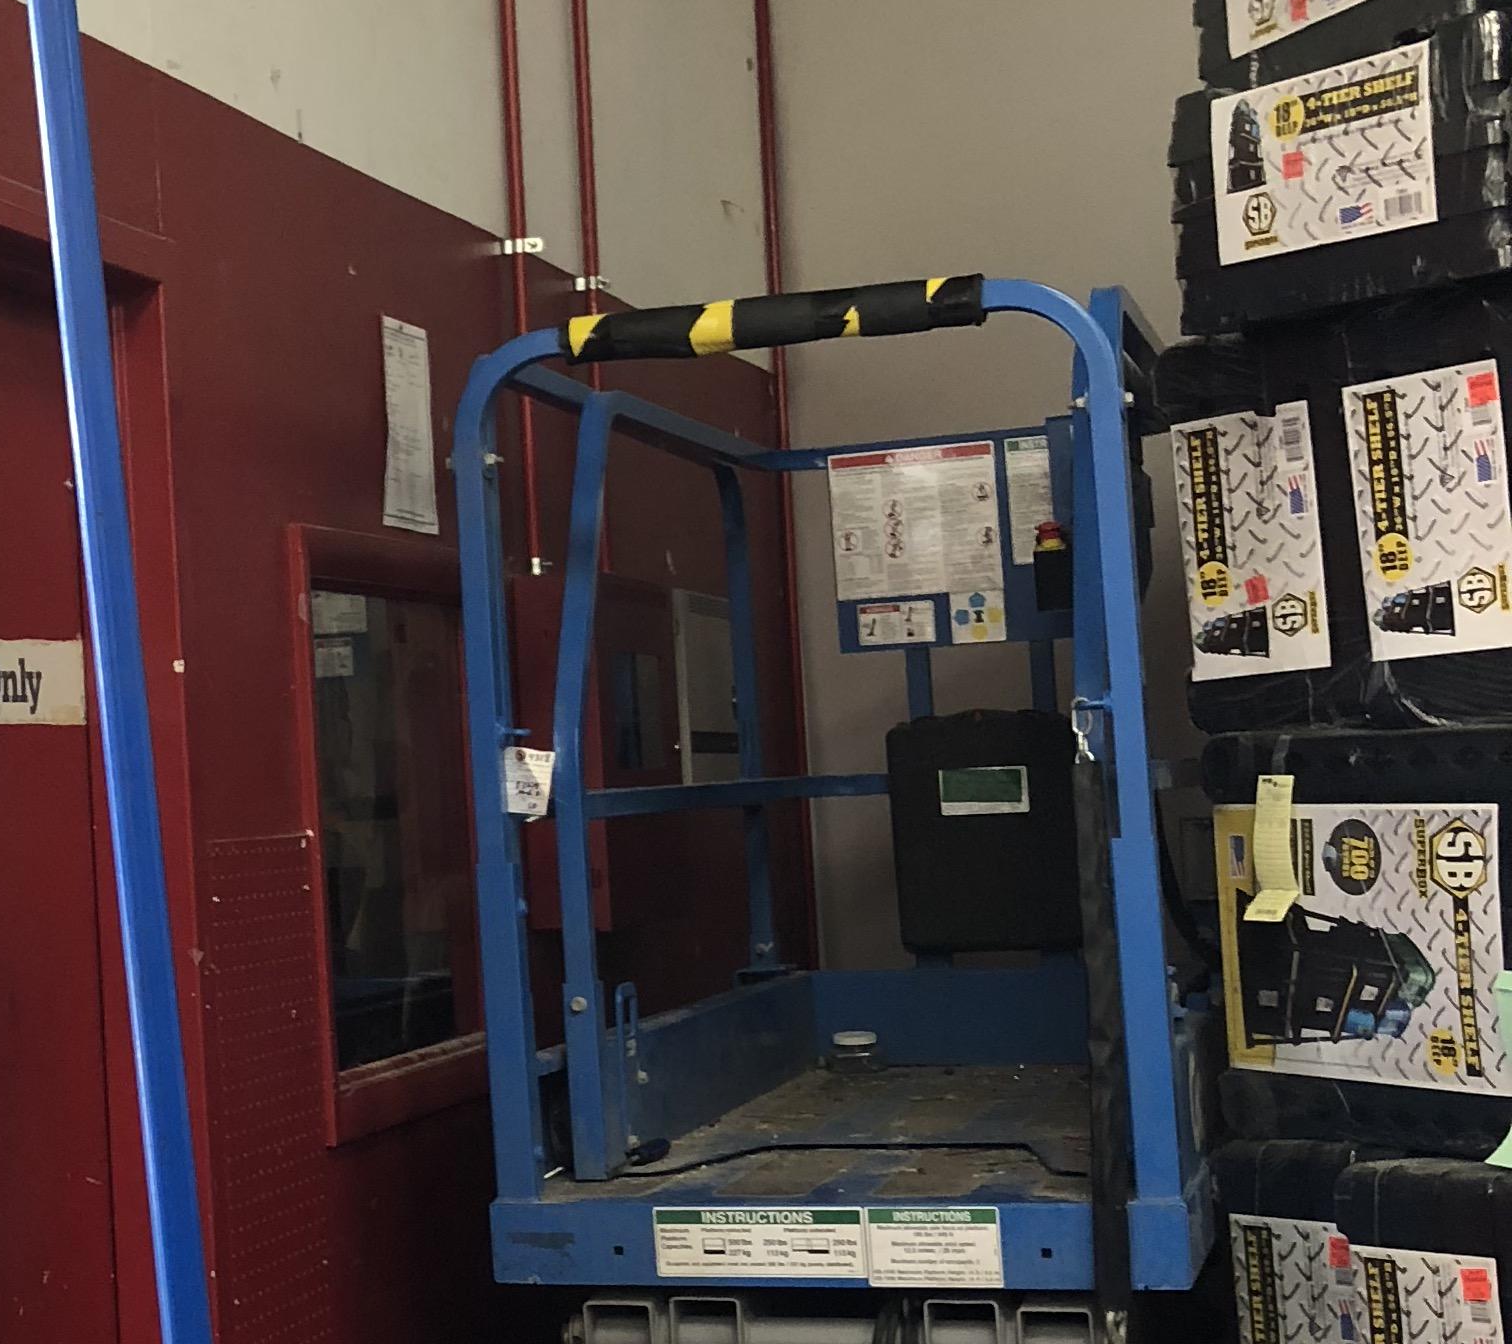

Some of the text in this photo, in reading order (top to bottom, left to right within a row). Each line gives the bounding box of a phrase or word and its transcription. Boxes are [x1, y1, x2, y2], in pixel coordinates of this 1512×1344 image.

[1366, 398, 1389, 532] 4-TIER SHELF
[1190, 435, 1210, 560] 4-TIER SHELF
[1348, 835, 1370, 881] 700
[1436, 829, 1485, 891] SB
[700, 1211, 814, 1224] INSTRUCTIONS
[891, 1211, 972, 1222] INSTRUCTIONS
[1368, 1262, 1384, 1329] SHELF
